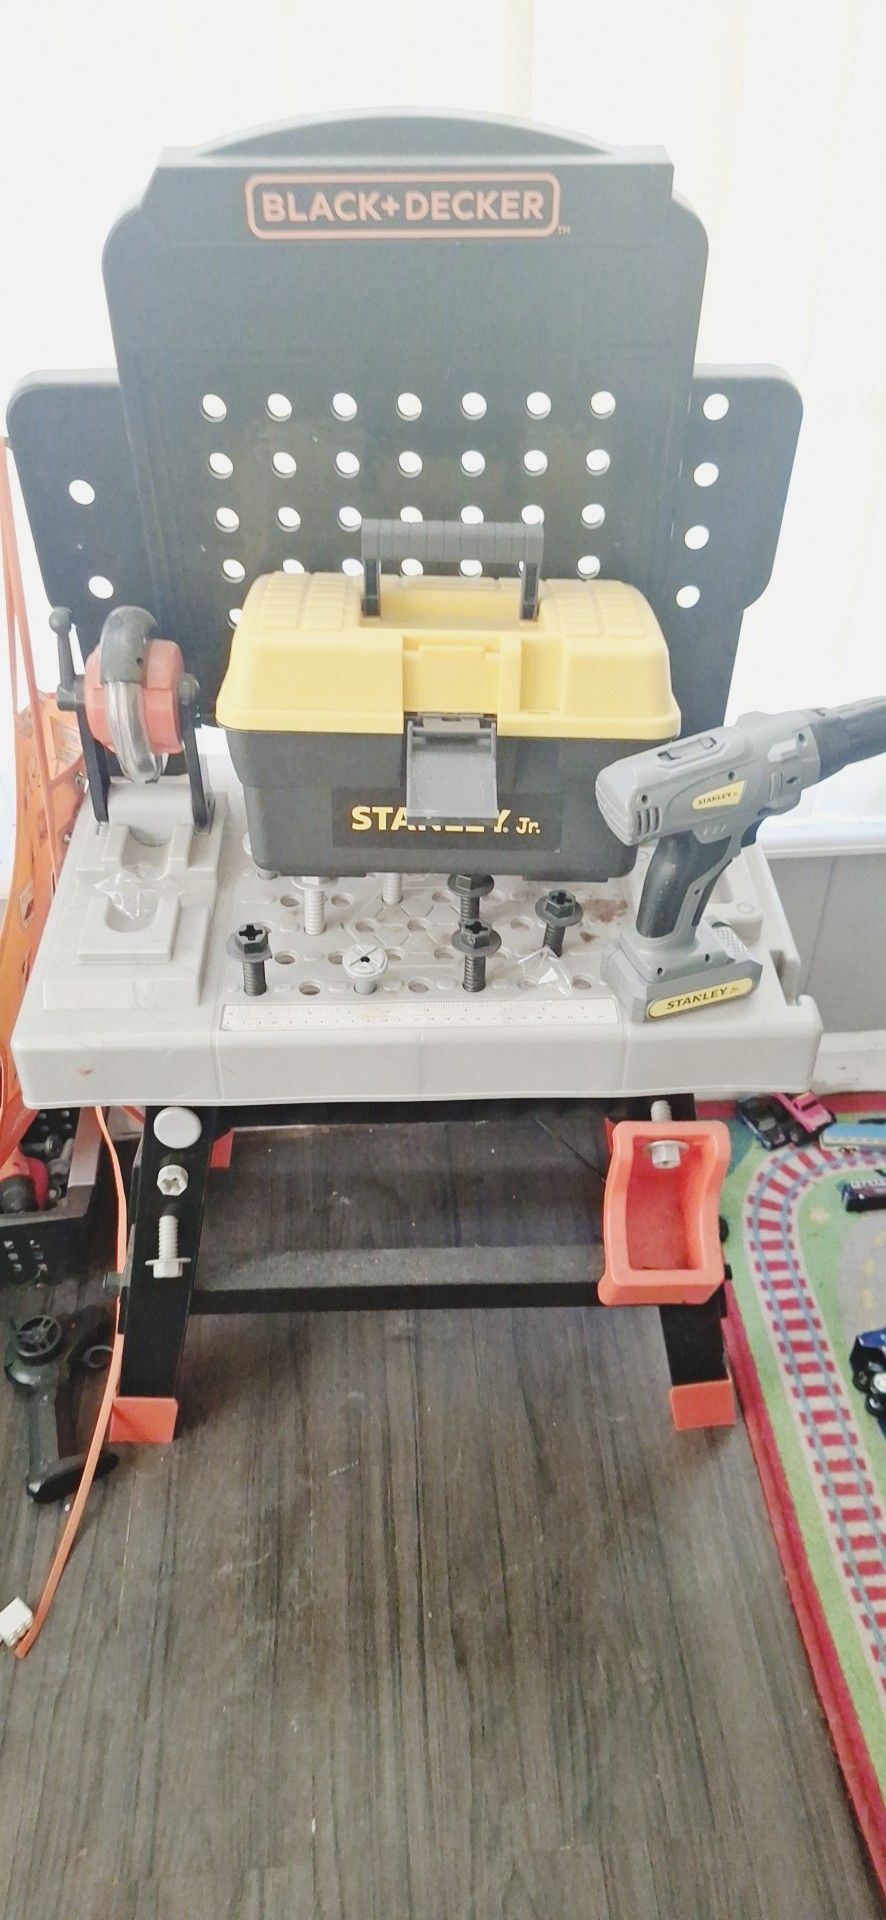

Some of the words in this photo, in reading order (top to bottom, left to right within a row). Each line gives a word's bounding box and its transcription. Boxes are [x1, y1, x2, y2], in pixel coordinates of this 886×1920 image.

[261, 190, 544, 222] BLACK+DECKER
[698, 792, 731, 805] STANLEY
[516, 816, 540, 834] Jr.
[667, 987, 727, 1009] STANLEY
